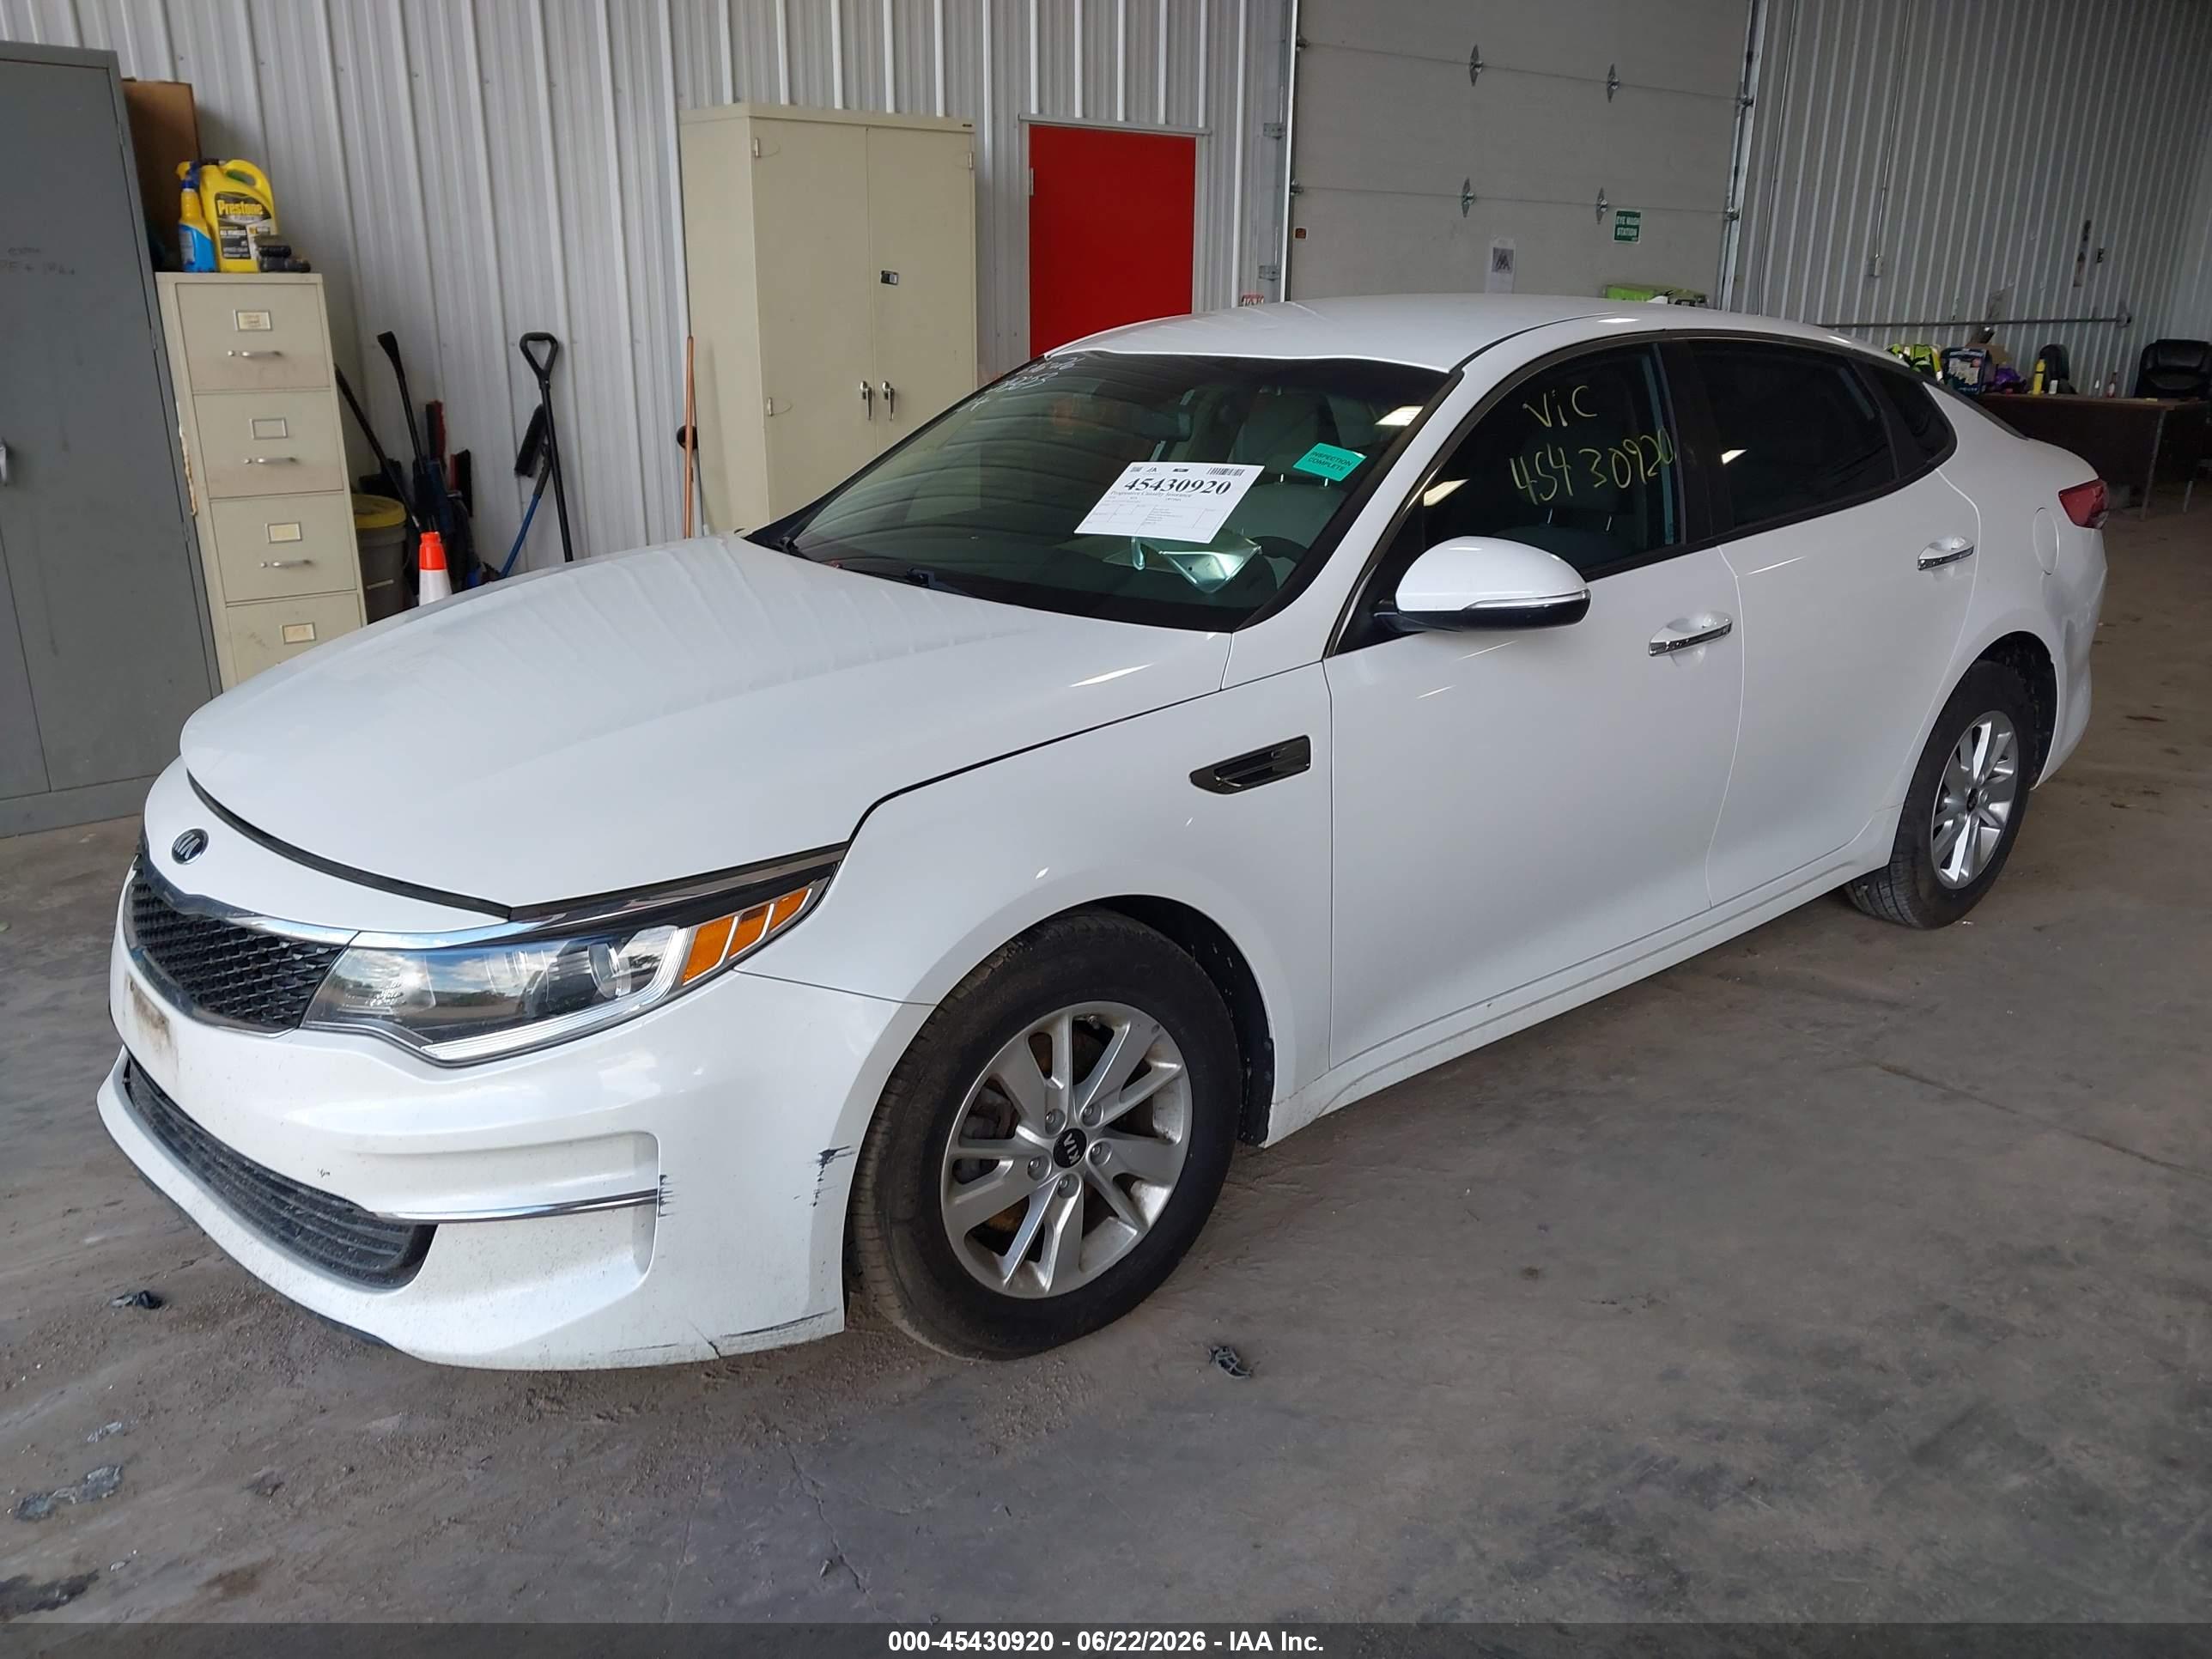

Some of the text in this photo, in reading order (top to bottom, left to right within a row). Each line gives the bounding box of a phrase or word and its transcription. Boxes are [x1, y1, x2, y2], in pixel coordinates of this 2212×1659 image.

[217, 199, 263, 216] Prestone
[1308, 457, 1346, 471] COMPLETE
[1310, 451, 1353, 466] INSPECTION
[1124, 477, 1231, 495] 45430920
[1063, 1133, 1080, 1165] KIA
